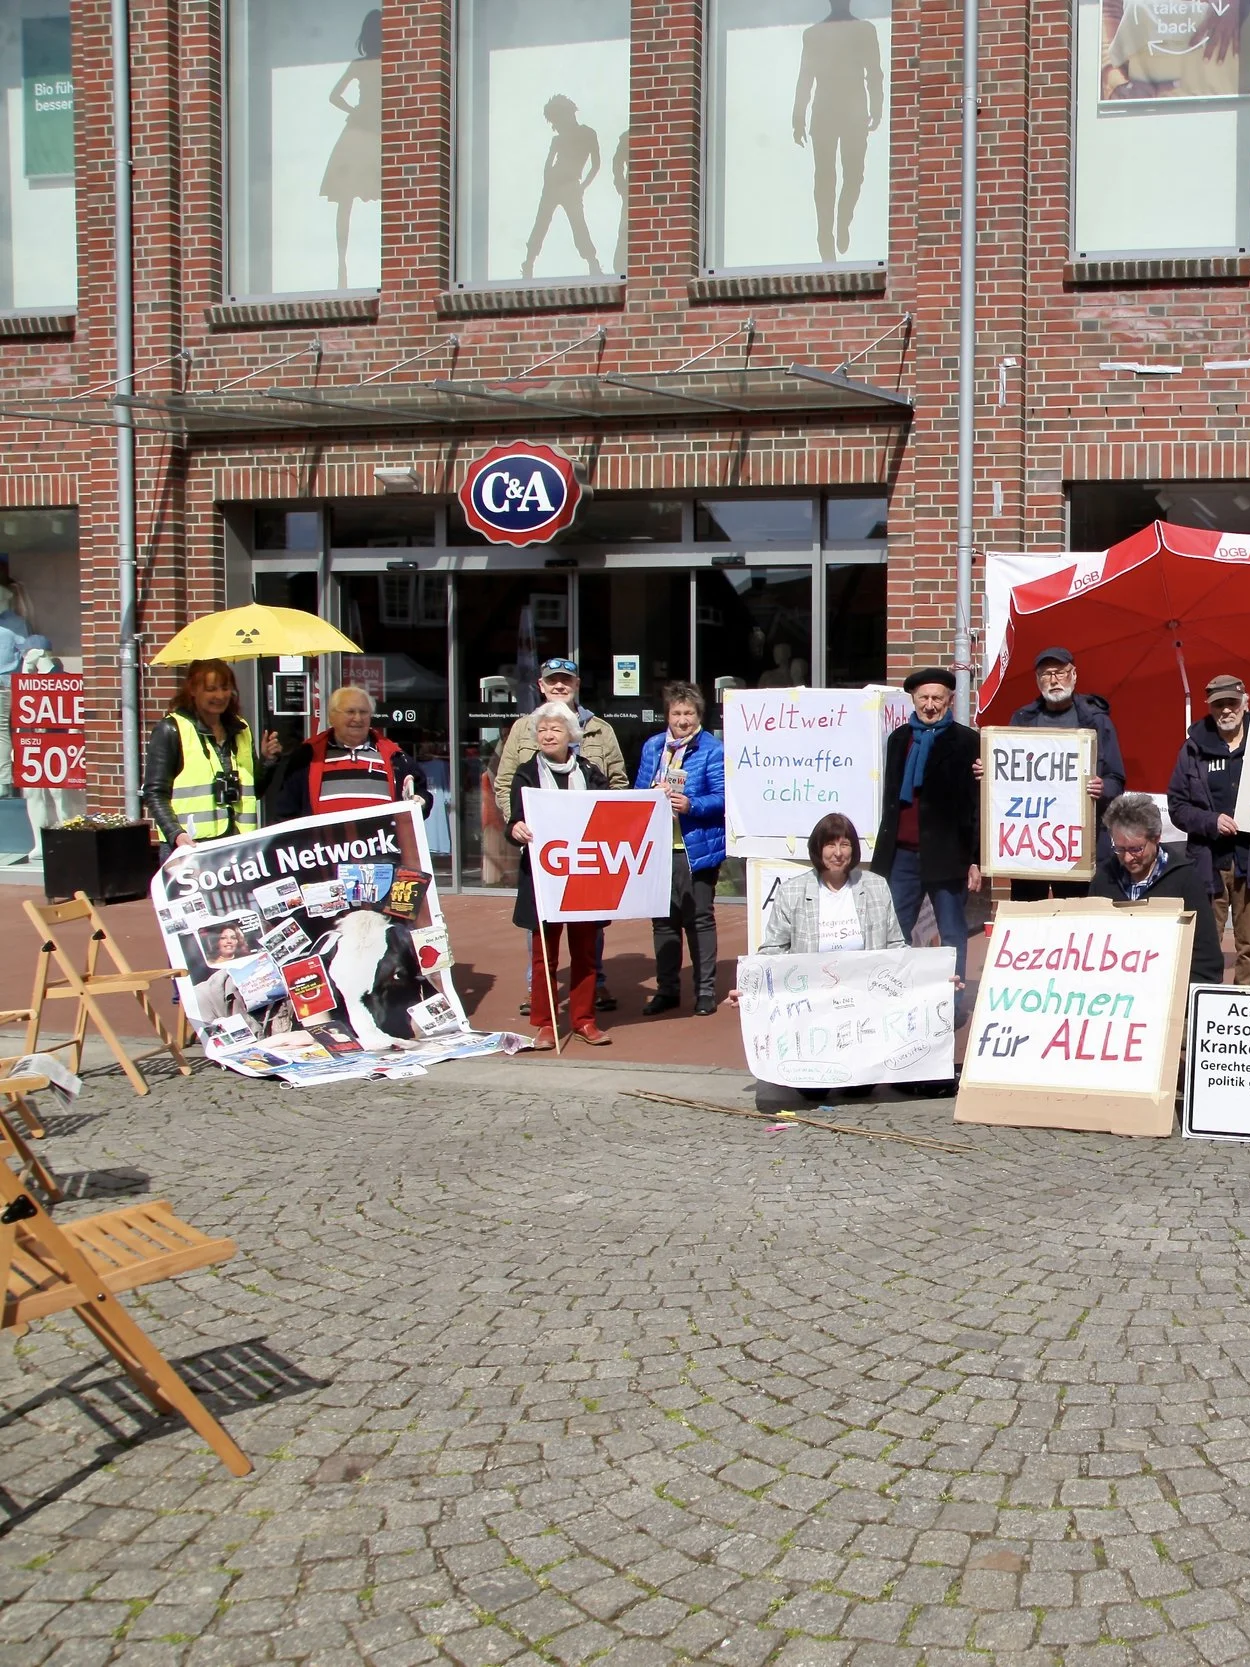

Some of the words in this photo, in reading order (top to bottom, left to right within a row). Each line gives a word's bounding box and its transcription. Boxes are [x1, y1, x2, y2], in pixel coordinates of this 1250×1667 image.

[1153, 1, 1187, 15] take
[1157, 18, 1197, 34] back
[34, 83, 53, 96] Bio
[55, 80, 74, 95] füh
[35, 99, 73, 112] besser
[482, 470, 554, 513] C&A
[1219, 547, 1248, 559] DGB
[1074, 571, 1100, 590] DGB
[19, 695, 85, 724] SALE
[741, 702, 848, 732] Weltweit
[20, 738, 31, 746] BIS
[33, 738, 42, 746] ZU
[21, 745, 87, 783] 50%
[738, 746, 854, 772] Atomwaffen
[762, 778, 840, 803] ächten
[998, 821, 1084, 864] KASSE
[175, 850, 272, 896] Social
[275, 828, 400, 875] Network
[539, 839, 654, 877] GEW
[994, 929, 1160, 973] bezahlbar
[988, 977, 1135, 1019] wohnen
[977, 1022, 1030, 1058] für
[1040, 1018, 1149, 1063] ALLE
[1207, 1075, 1246, 1092] politik
